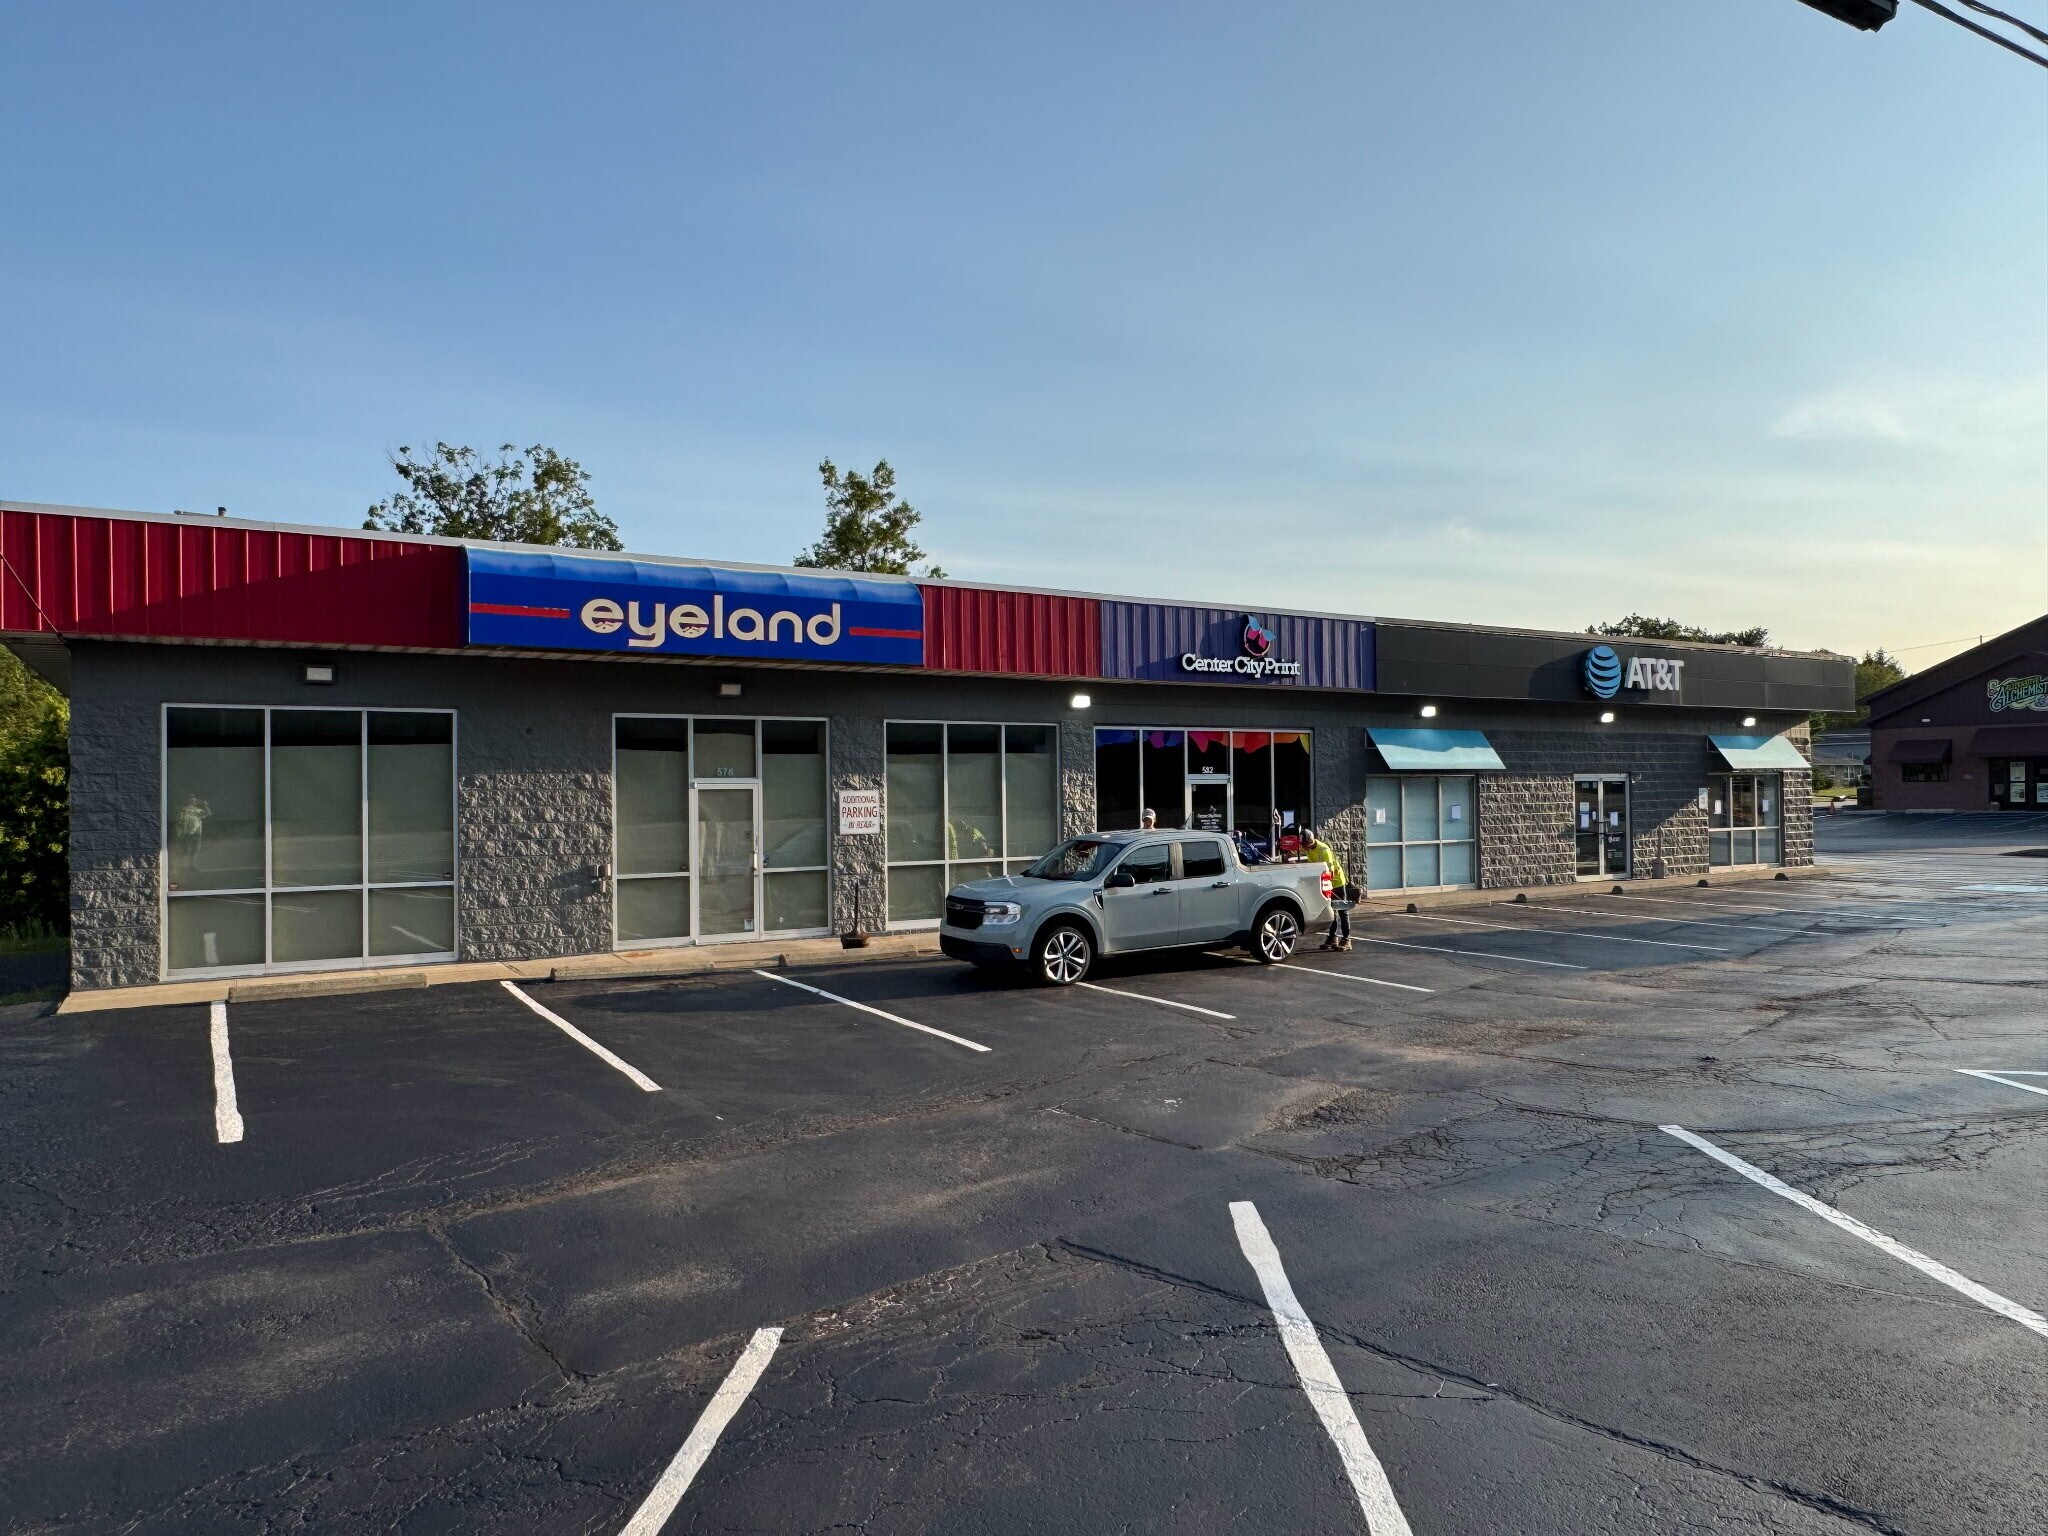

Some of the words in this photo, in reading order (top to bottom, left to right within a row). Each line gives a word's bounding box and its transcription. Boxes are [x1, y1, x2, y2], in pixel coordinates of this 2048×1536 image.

[581, 594, 841, 648] eyeland
[1182, 653, 1233, 672] Center
[1234, 656, 1265, 678] City
[1264, 658, 1301, 675] Print
[1626, 656, 1685, 691] AT&T
[842, 795, 877, 803] ADDITIONAL
[841, 806, 878, 818] PARKING
